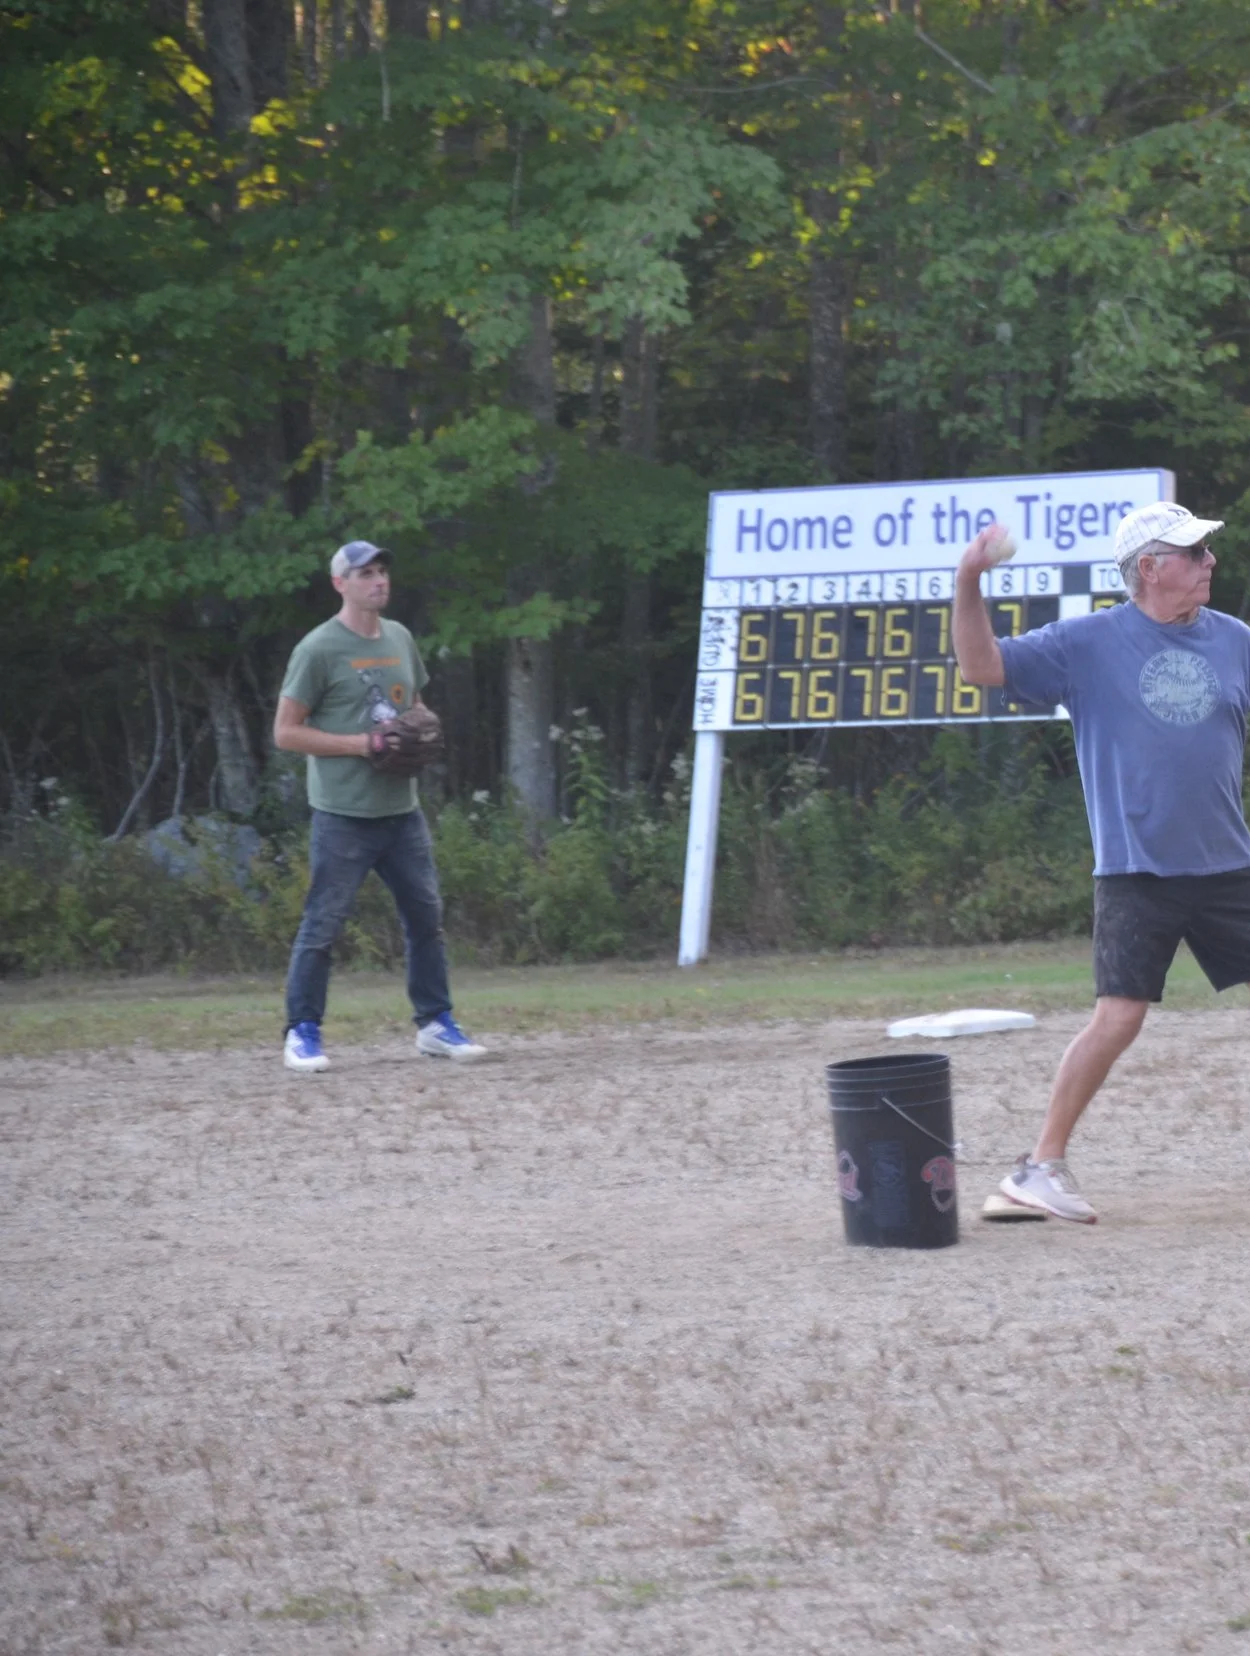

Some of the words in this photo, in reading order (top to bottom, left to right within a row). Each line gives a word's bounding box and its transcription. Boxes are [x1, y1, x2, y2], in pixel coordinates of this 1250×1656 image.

[736, 508, 853, 553] Home
[873, 497, 915, 547] of
[931, 495, 996, 545] the
[788, 582, 799, 602] 2
[823, 580, 836, 600] 3
[856, 579, 871, 599] 4
[895, 578, 907, 600] 5
[928, 576, 941, 597] 6
[1001, 572, 1013, 593] 8
[1036, 571, 1049, 592] 9
[699, 678, 718, 724] HOME
